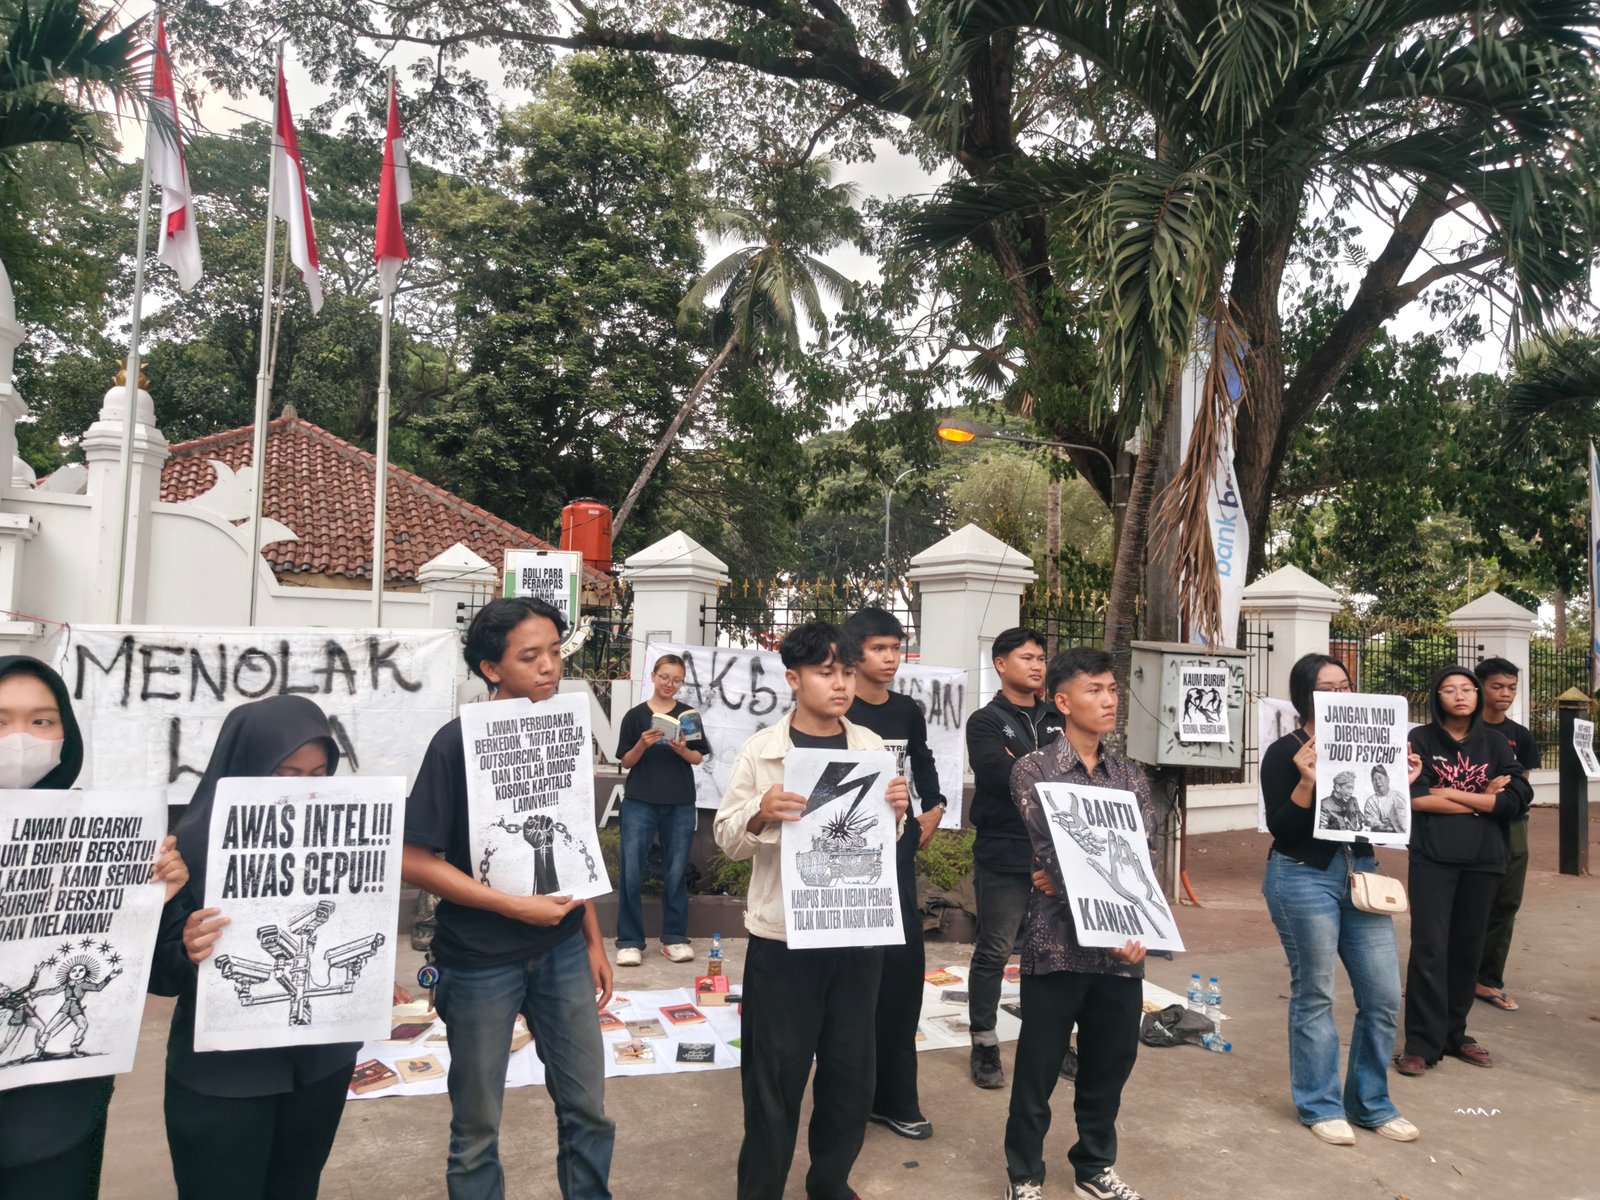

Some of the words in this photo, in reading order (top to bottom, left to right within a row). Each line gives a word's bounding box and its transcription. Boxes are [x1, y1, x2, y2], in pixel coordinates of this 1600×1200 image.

[1215, 514, 1238, 576] bank
[522, 568, 541, 578] ADILI
[543, 568, 563, 579] PARA
[522, 578, 563, 589] PERAMPAS
[74, 634, 423, 707] MENOLAK
[1183, 673, 1202, 686] KAUM
[1203, 673, 1226, 687] BURUH
[486, 719, 518, 737] LAWAN
[520, 712, 574, 732] PERBUDAKAN
[1324, 705, 1368, 725] JANGAN
[1371, 707, 1395, 726] MAU
[474, 735, 521, 755] BERKEDOK
[525, 731, 556, 747] "MITRA
[558, 726, 585, 743] KERJA,
[1334, 725, 1390, 745] DIBOHONGI
[480, 750, 544, 770] OUTSOURCING,
[546, 741, 584, 760] MAGANG"
[1324, 743, 1352, 762] "DUO
[1355, 746, 1401, 764] PSYCHO"
[491, 769, 511, 785] DAN
[513, 762, 544, 781] ISTILAH
[547, 758, 576, 776] OMONG
[495, 782, 530, 801] KOSONG
[532, 775, 572, 795] KAPITALIS
[513, 791, 559, 814] LAINNYA!!!!
[1082, 797, 1138, 832] BANTU
[11, 817, 67, 842] LAWAN
[68, 816, 143, 839] OLIGARKI!
[222, 804, 296, 849] AWAS
[303, 803, 393, 847] INTEL!!!
[0, 843, 29, 867] UM
[31, 841, 84, 866] BURUH
[85, 840, 157, 864] BERSATU!
[60, 865, 100, 888] KAMI
[105, 863, 155, 886] SEMUA
[222, 852, 296, 899] AWAS
[303, 850, 387, 896] CEPU!!!
[54, 888, 124, 912] BERSATU
[791, 889, 819, 909] KAMPUS
[821, 888, 843, 908] BUKAN
[844, 888, 867, 907] MEDAN
[868, 887, 892, 907] PERANG
[30, 912, 113, 938] MELAWAN!
[793, 910, 815, 931] TOLAK
[815, 909, 841, 930] MILITER
[843, 908, 866, 928] MASUK
[867, 908, 894, 928] KAMPUS
[1078, 897, 1144, 936] KAWAN
